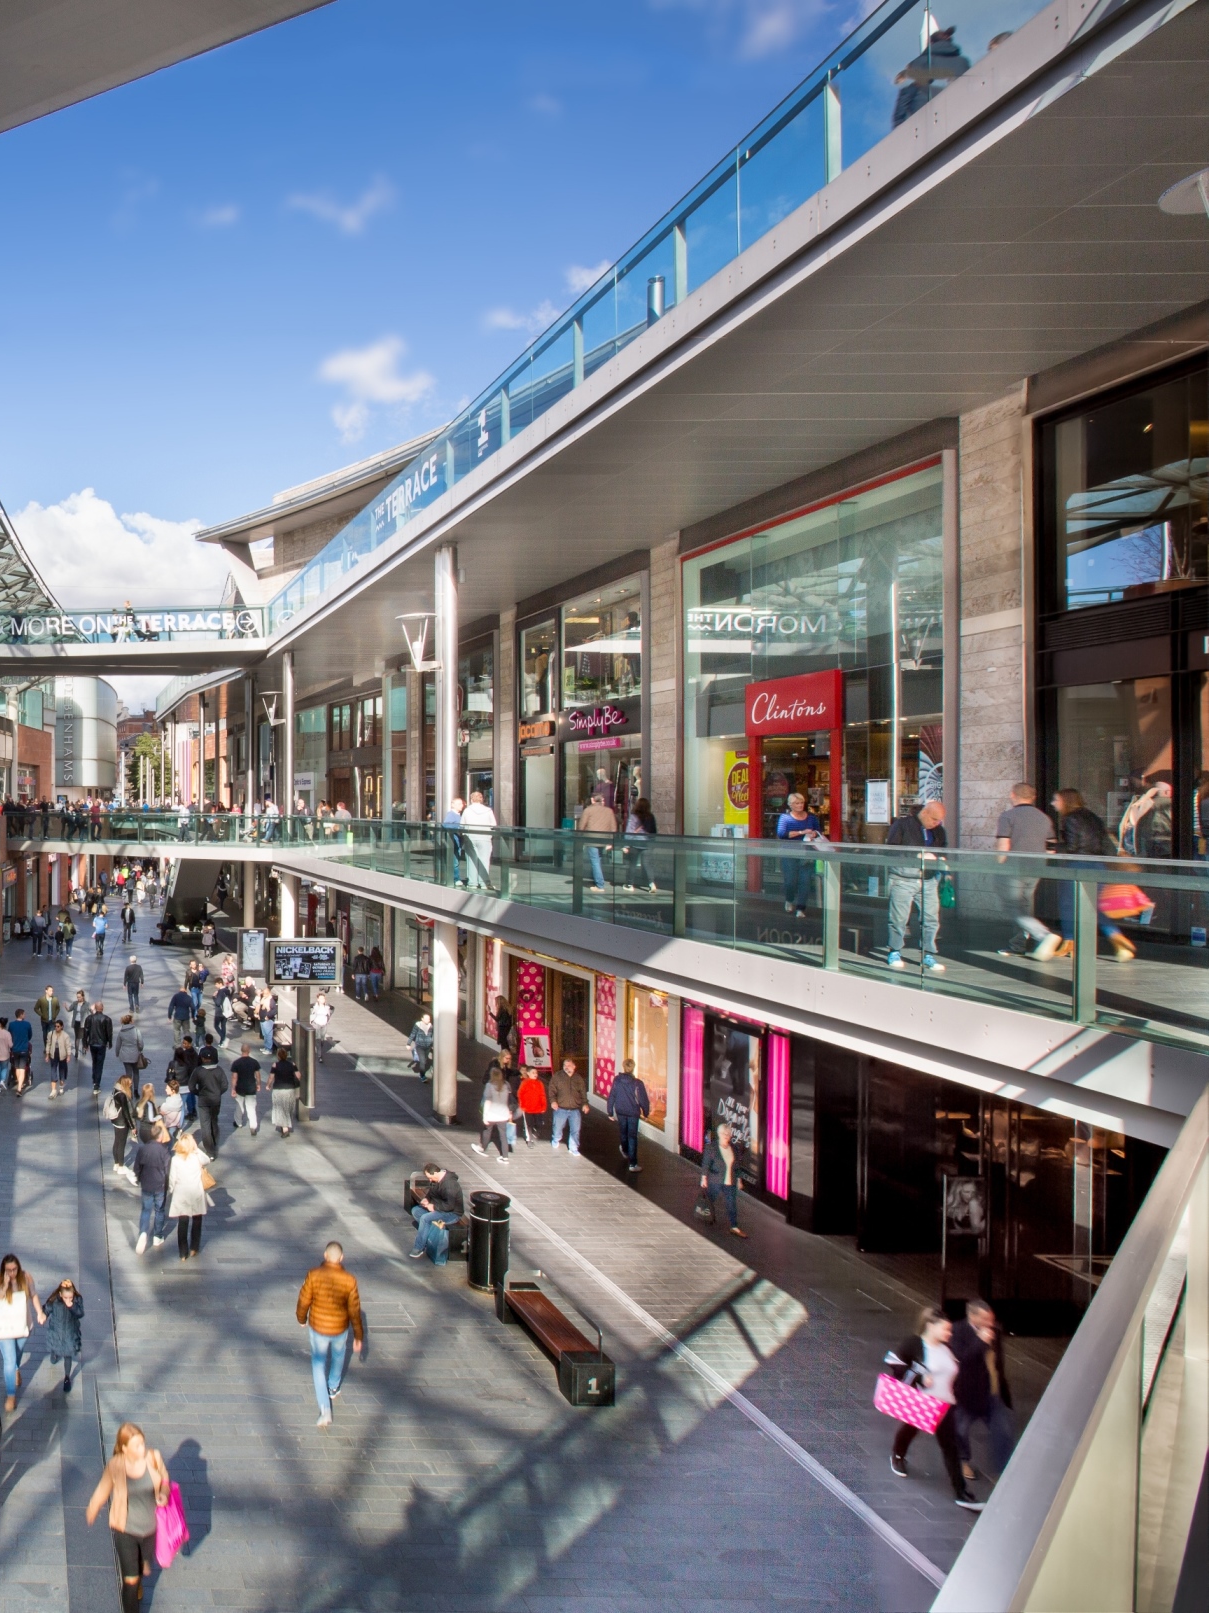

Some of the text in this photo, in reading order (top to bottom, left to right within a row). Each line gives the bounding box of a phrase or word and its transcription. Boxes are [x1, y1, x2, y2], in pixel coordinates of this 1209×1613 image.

[375, 453, 438, 522] THE TERRACE
[11, 616, 76, 636] MORE
[79, 616, 111, 635] ON
[113, 615, 133, 624] THE
[139, 613, 234, 632] TERRACE
[751, 692, 827, 725] Clintons
[276, 946, 334, 954] NICKELBACK
[587, 1377, 600, 1395] 1
